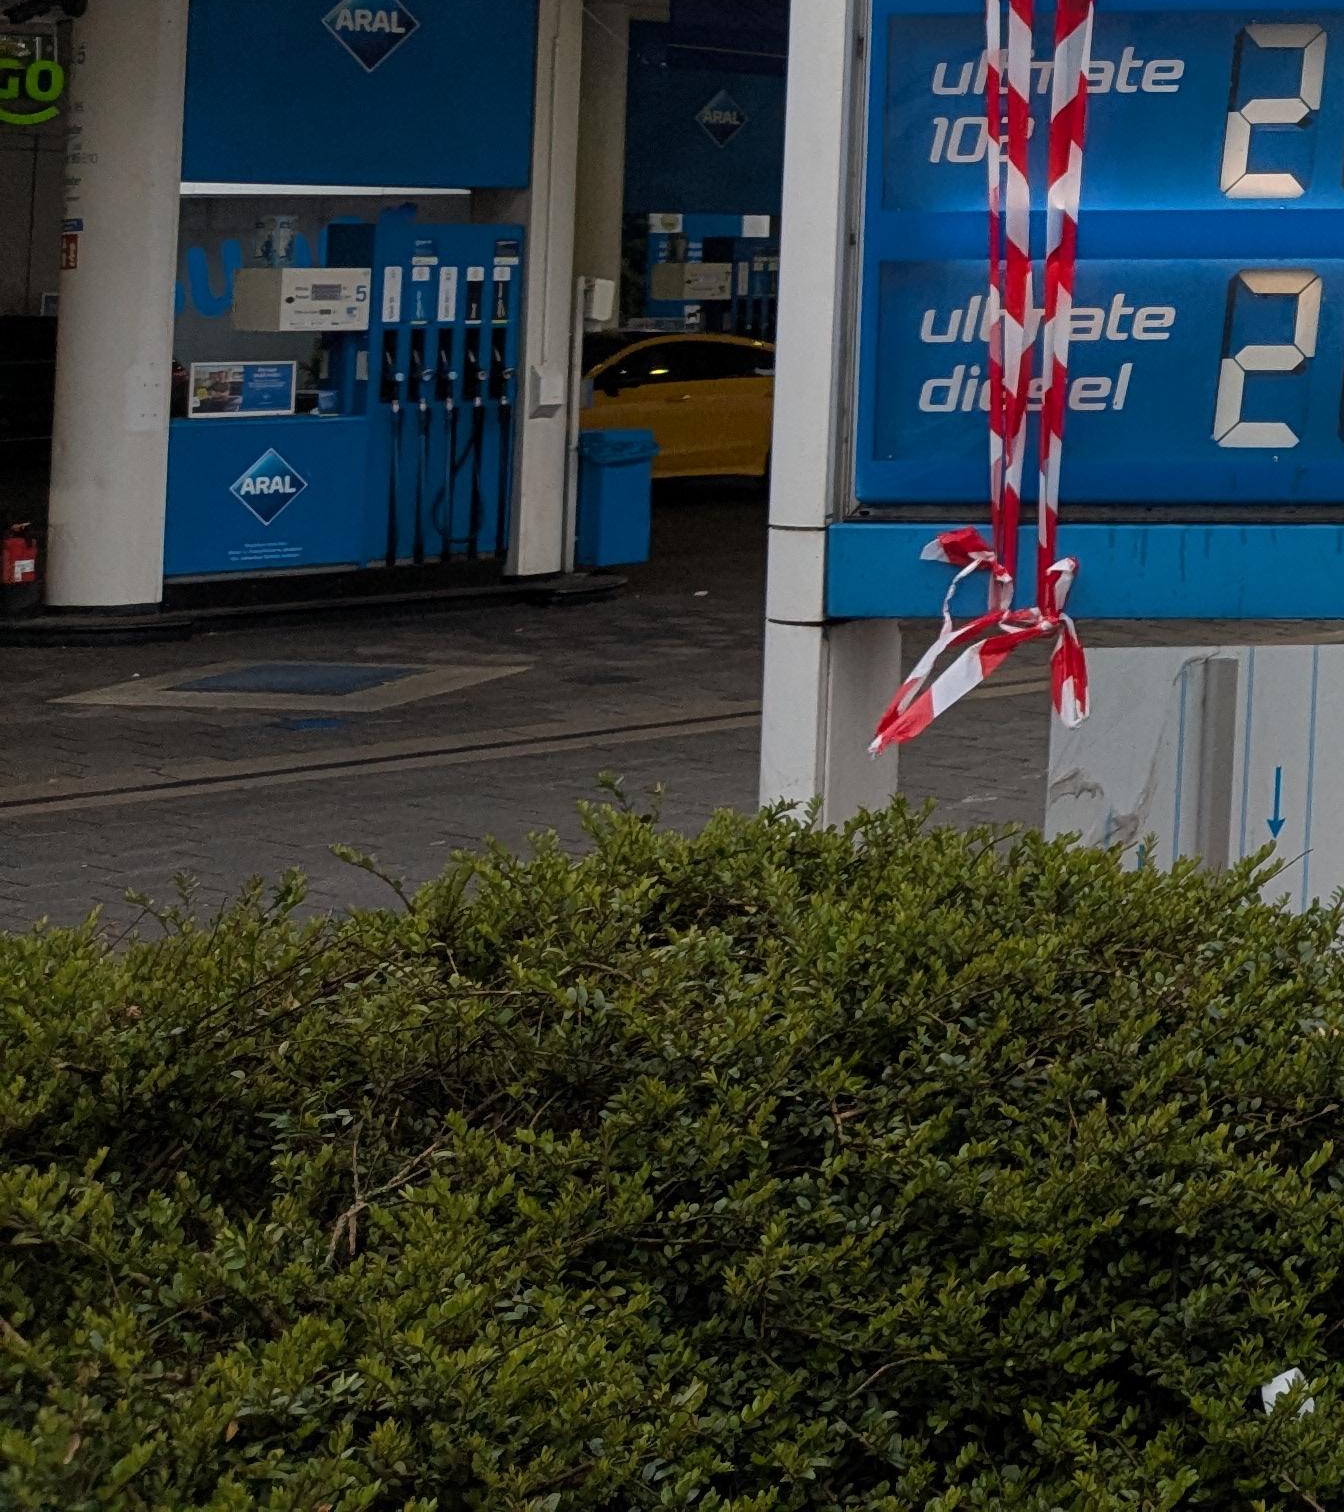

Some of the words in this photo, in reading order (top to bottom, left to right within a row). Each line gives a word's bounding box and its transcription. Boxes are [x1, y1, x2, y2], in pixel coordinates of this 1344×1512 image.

[335, 8, 406, 33] ARAL
[932, 46, 1185, 96] ulate
[702, 108, 743, 127] ARAL
[356, 285, 367, 302] 5
[920, 293, 1176, 343] ulate
[918, 362, 1134, 413] diel
[239, 475, 297, 496] ARAL
